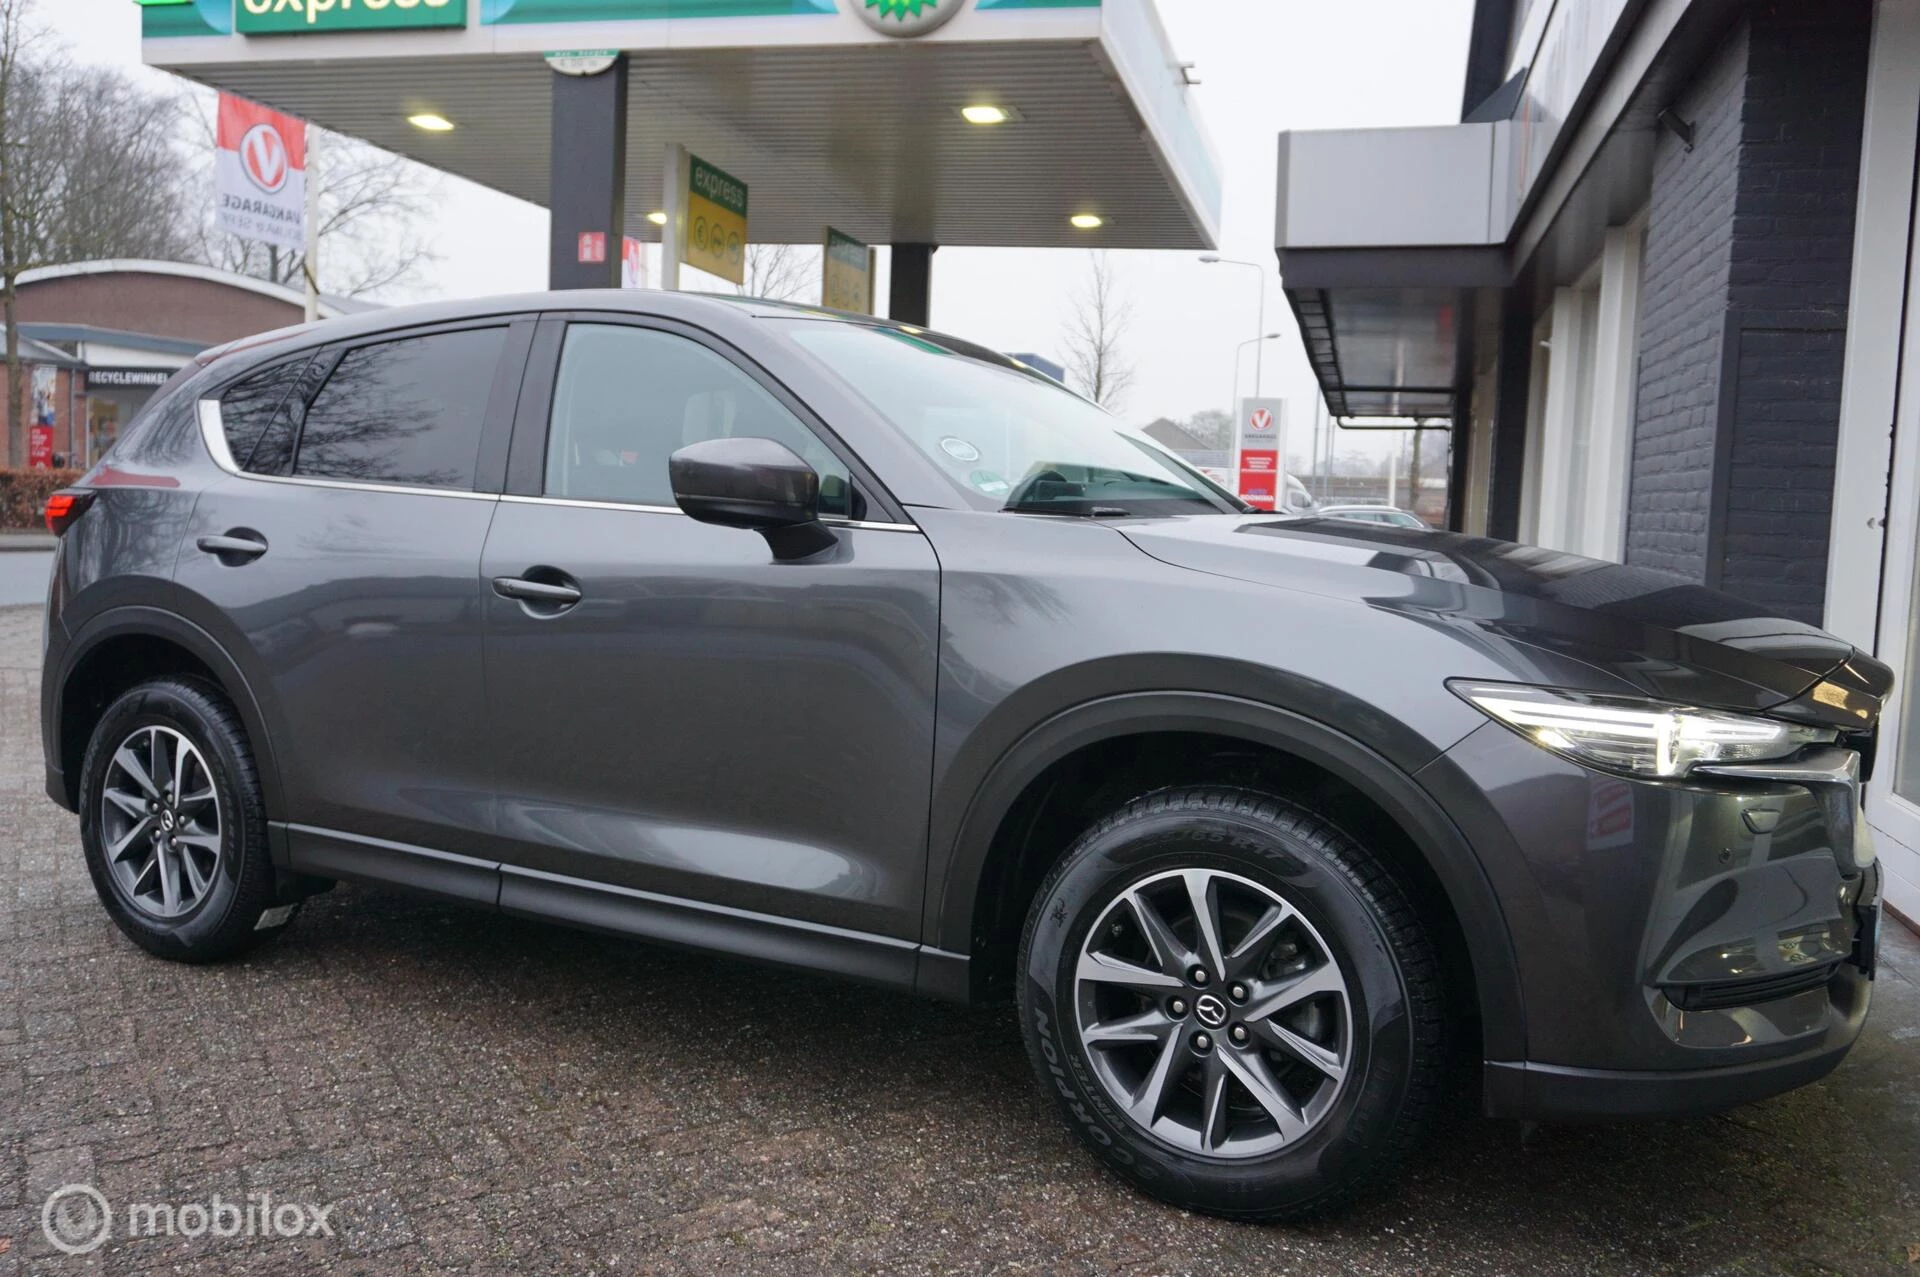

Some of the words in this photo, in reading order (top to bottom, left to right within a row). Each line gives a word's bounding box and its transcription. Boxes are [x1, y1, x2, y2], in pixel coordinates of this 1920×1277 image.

[695, 165, 744, 208] express
[1034, 1006, 1160, 1180] SCORPION
[1068, 1053, 1126, 1131] WINTER
